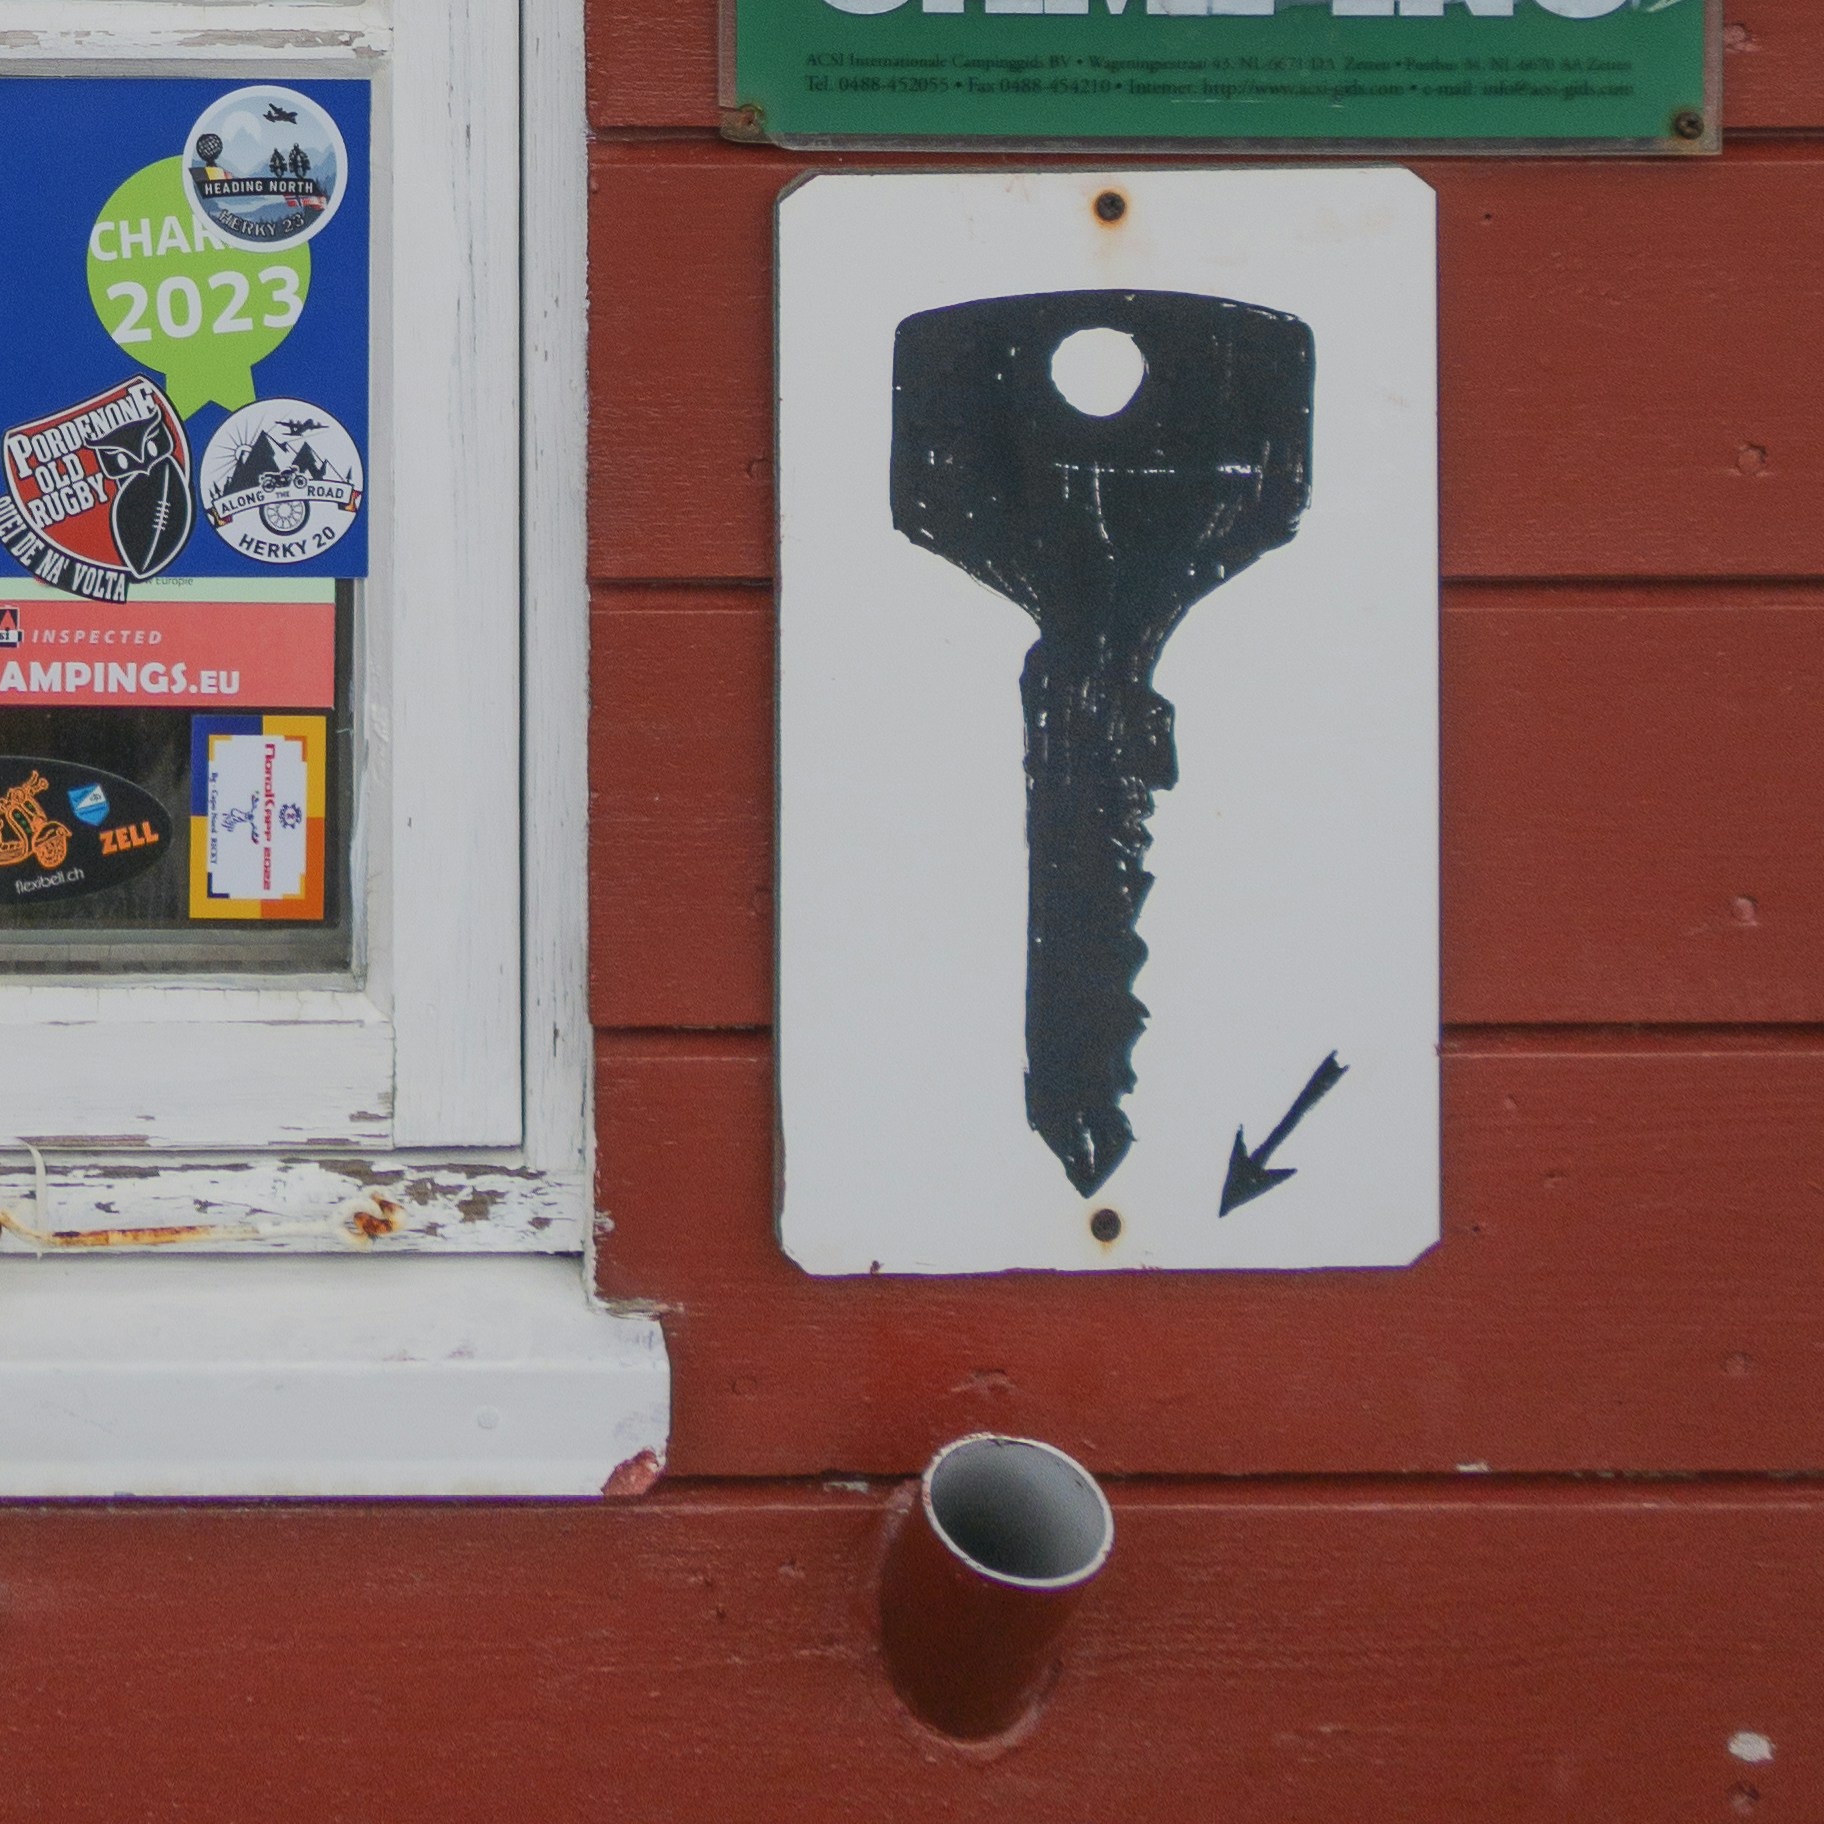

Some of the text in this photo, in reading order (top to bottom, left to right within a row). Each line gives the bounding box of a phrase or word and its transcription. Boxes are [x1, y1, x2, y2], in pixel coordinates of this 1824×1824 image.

[203, 180, 314, 194] HEADING NORTH
[106, 265, 304, 343] 2023
[32, 629, 163, 644] INSPECTED
[99, 822, 159, 855] ZELL
